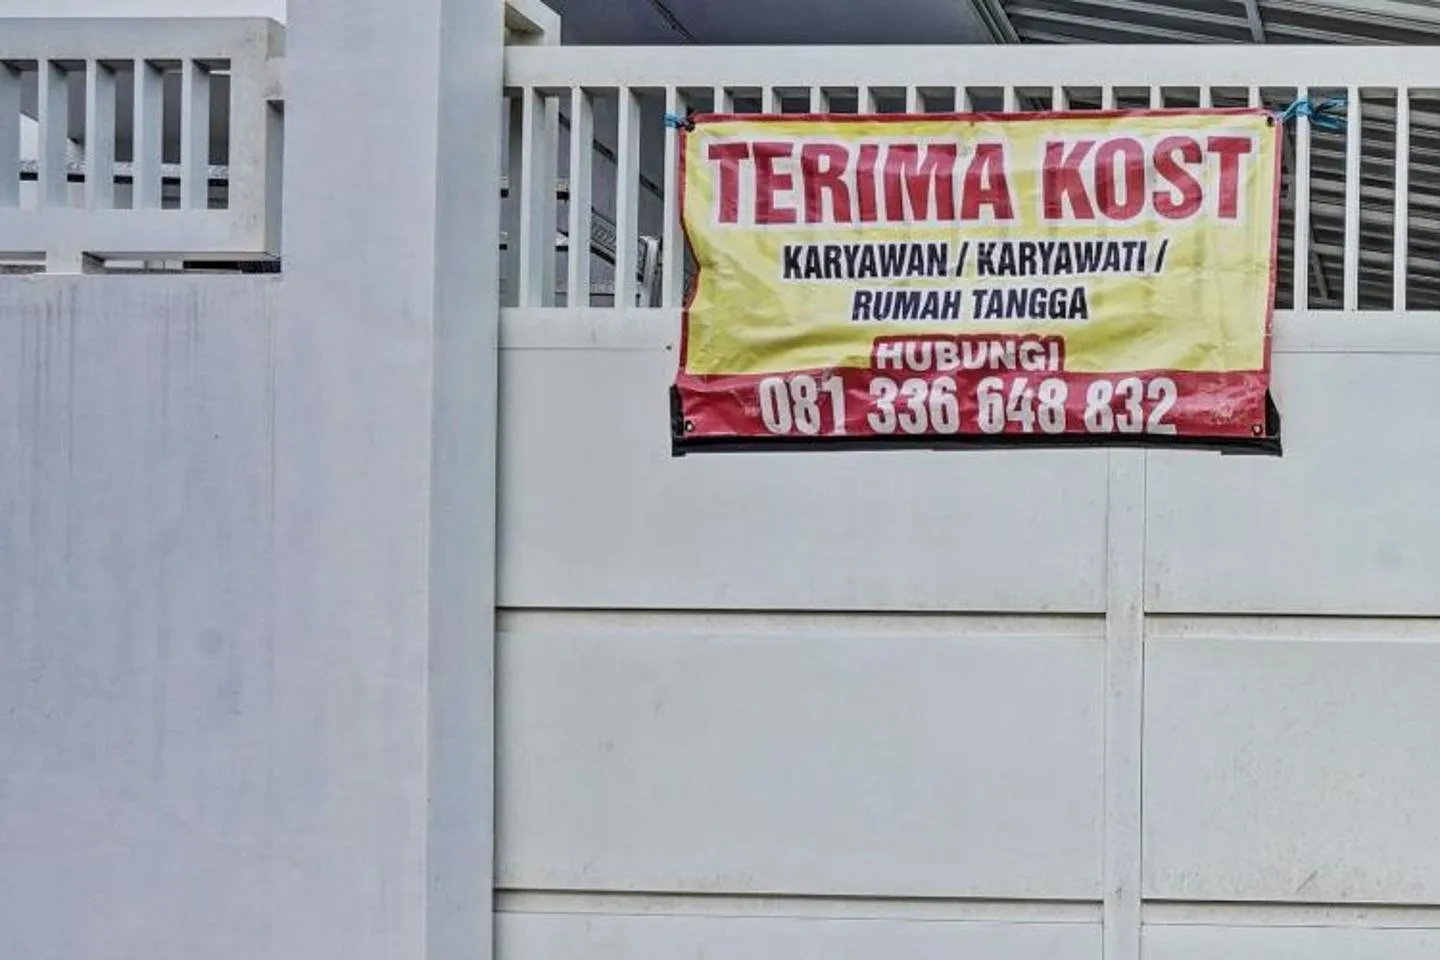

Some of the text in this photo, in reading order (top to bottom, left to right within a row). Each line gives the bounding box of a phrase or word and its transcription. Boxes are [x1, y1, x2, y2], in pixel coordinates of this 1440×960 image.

[708, 136, 1253, 225] TERIMA KOST
[783, 239, 1169, 279] KARYAWAN / KARYAWATI /
[852, 287, 1089, 321] RUMAH TANGGA
[876, 339, 1060, 372] HUBUNGI
[759, 375, 1177, 436] 081 336 648 832
